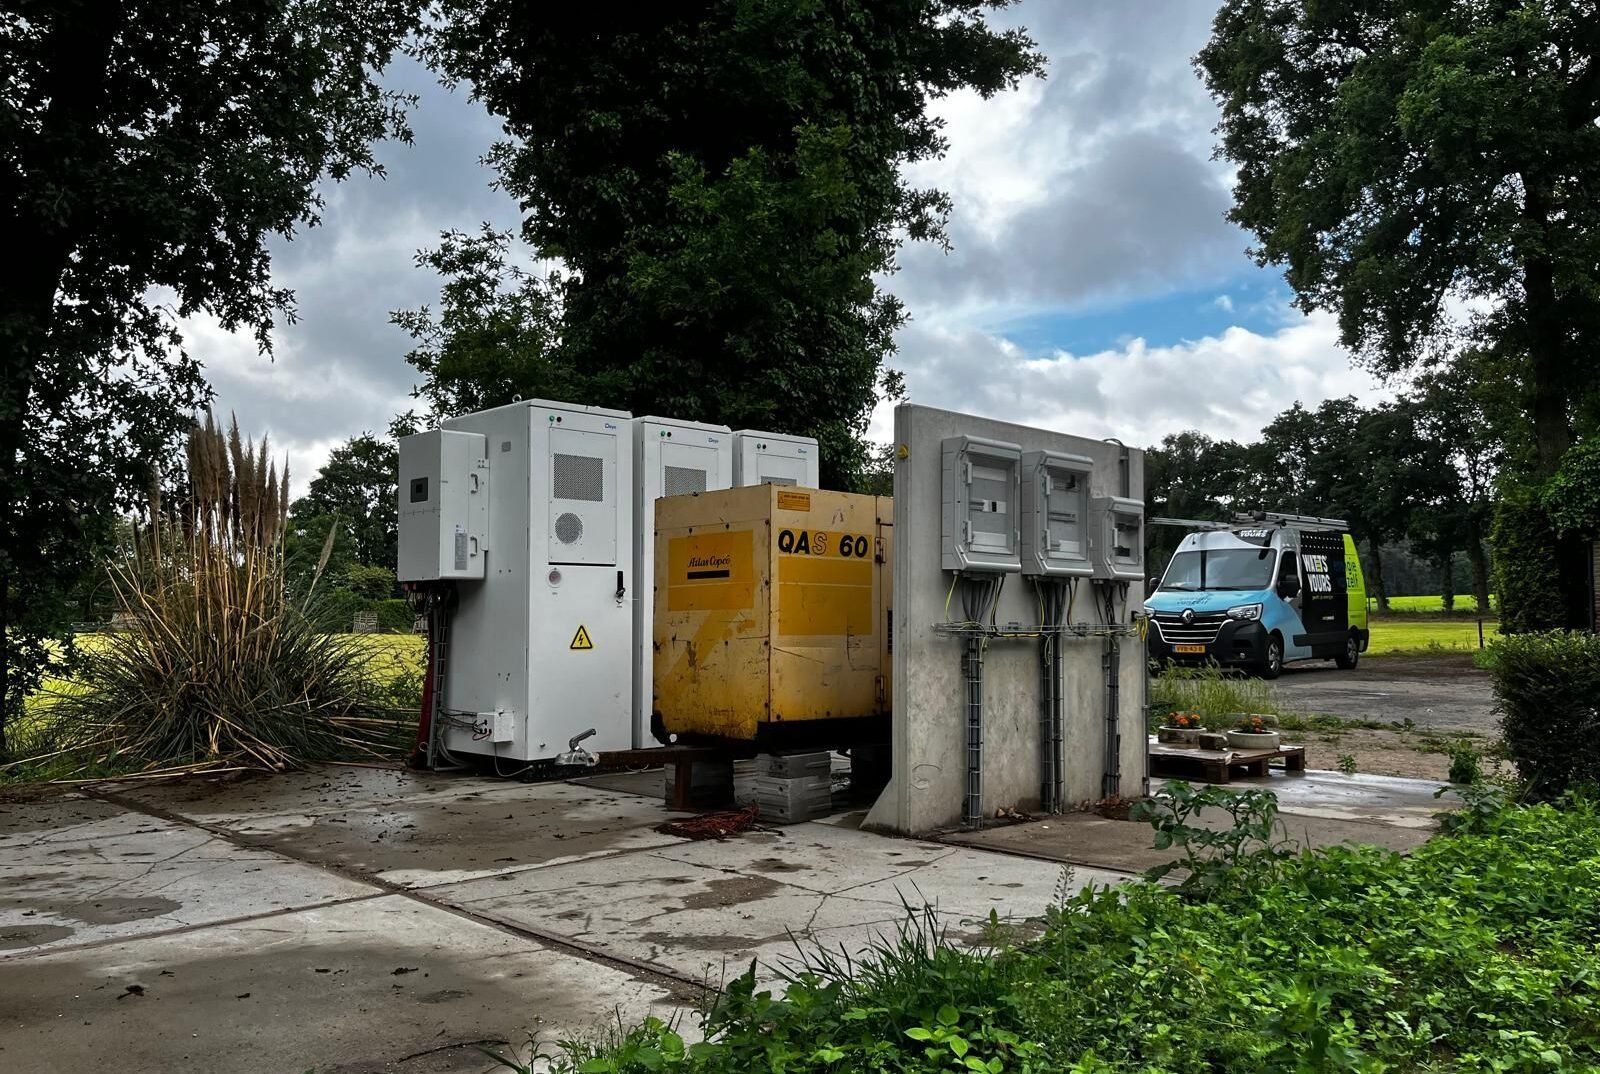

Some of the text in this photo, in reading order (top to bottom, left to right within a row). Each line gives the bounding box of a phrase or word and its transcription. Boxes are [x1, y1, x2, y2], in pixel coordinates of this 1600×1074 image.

[778, 530, 869, 559] QAS 60
[687, 555, 730, 568] Atlas Copco
[1307, 573, 1332, 592] YOURS
